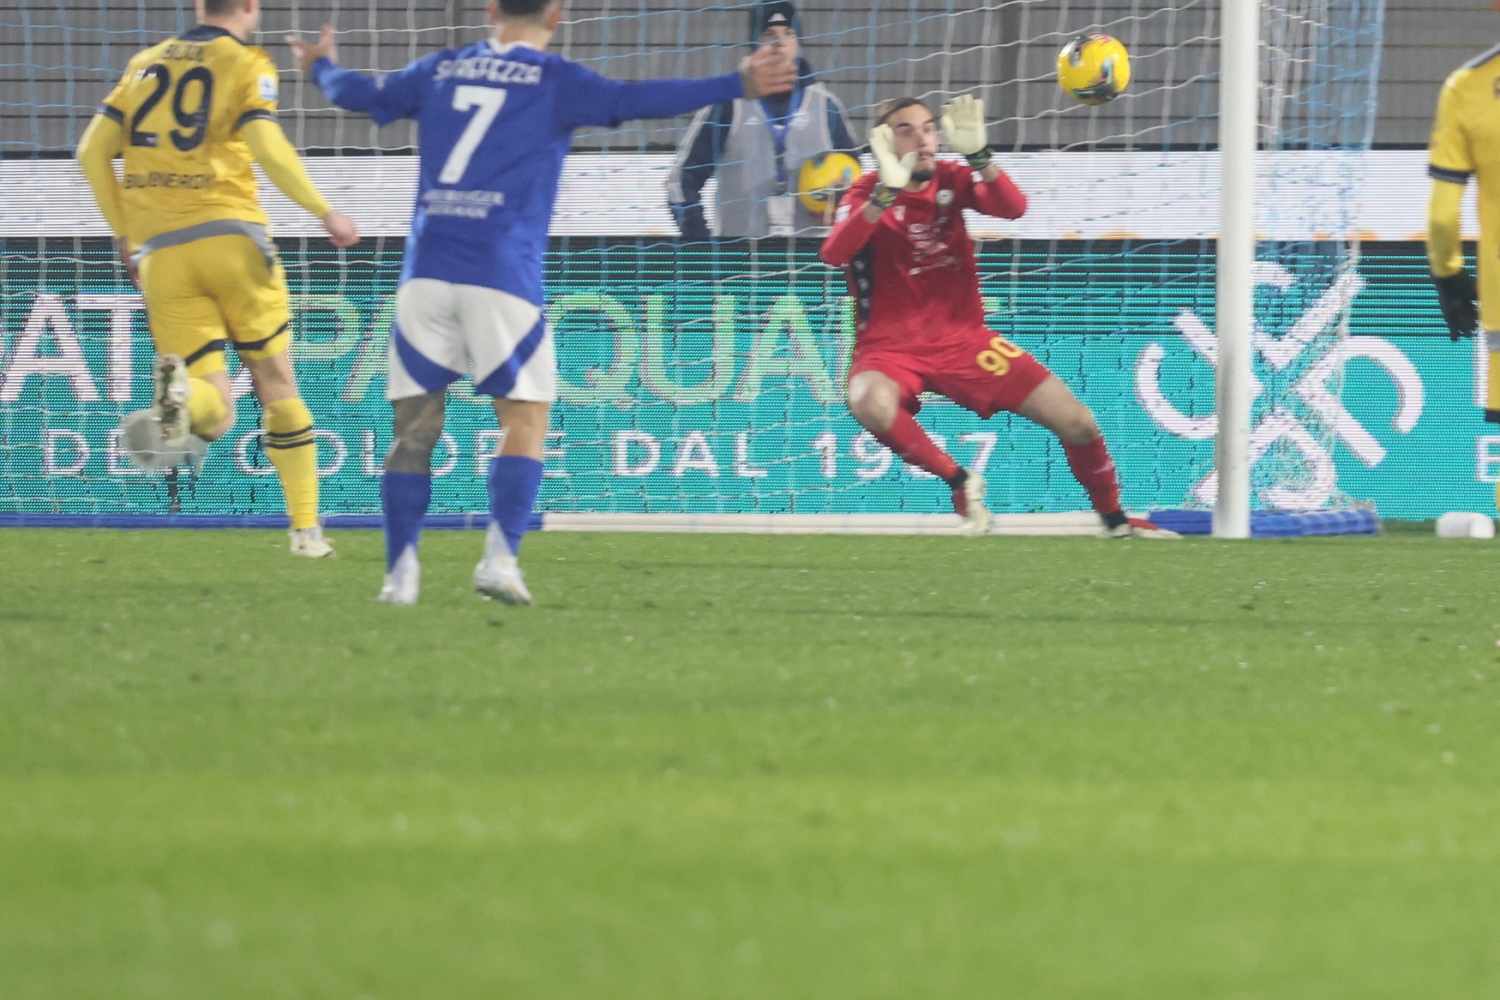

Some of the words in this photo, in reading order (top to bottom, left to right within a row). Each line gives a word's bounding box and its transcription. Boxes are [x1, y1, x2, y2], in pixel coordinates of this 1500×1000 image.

[130, 63, 214, 152] 29
[438, 84, 508, 184] 7
[976, 336, 1025, 376] 90
[610, 430, 769, 478] DAL
[810, 431, 999, 480] 197
